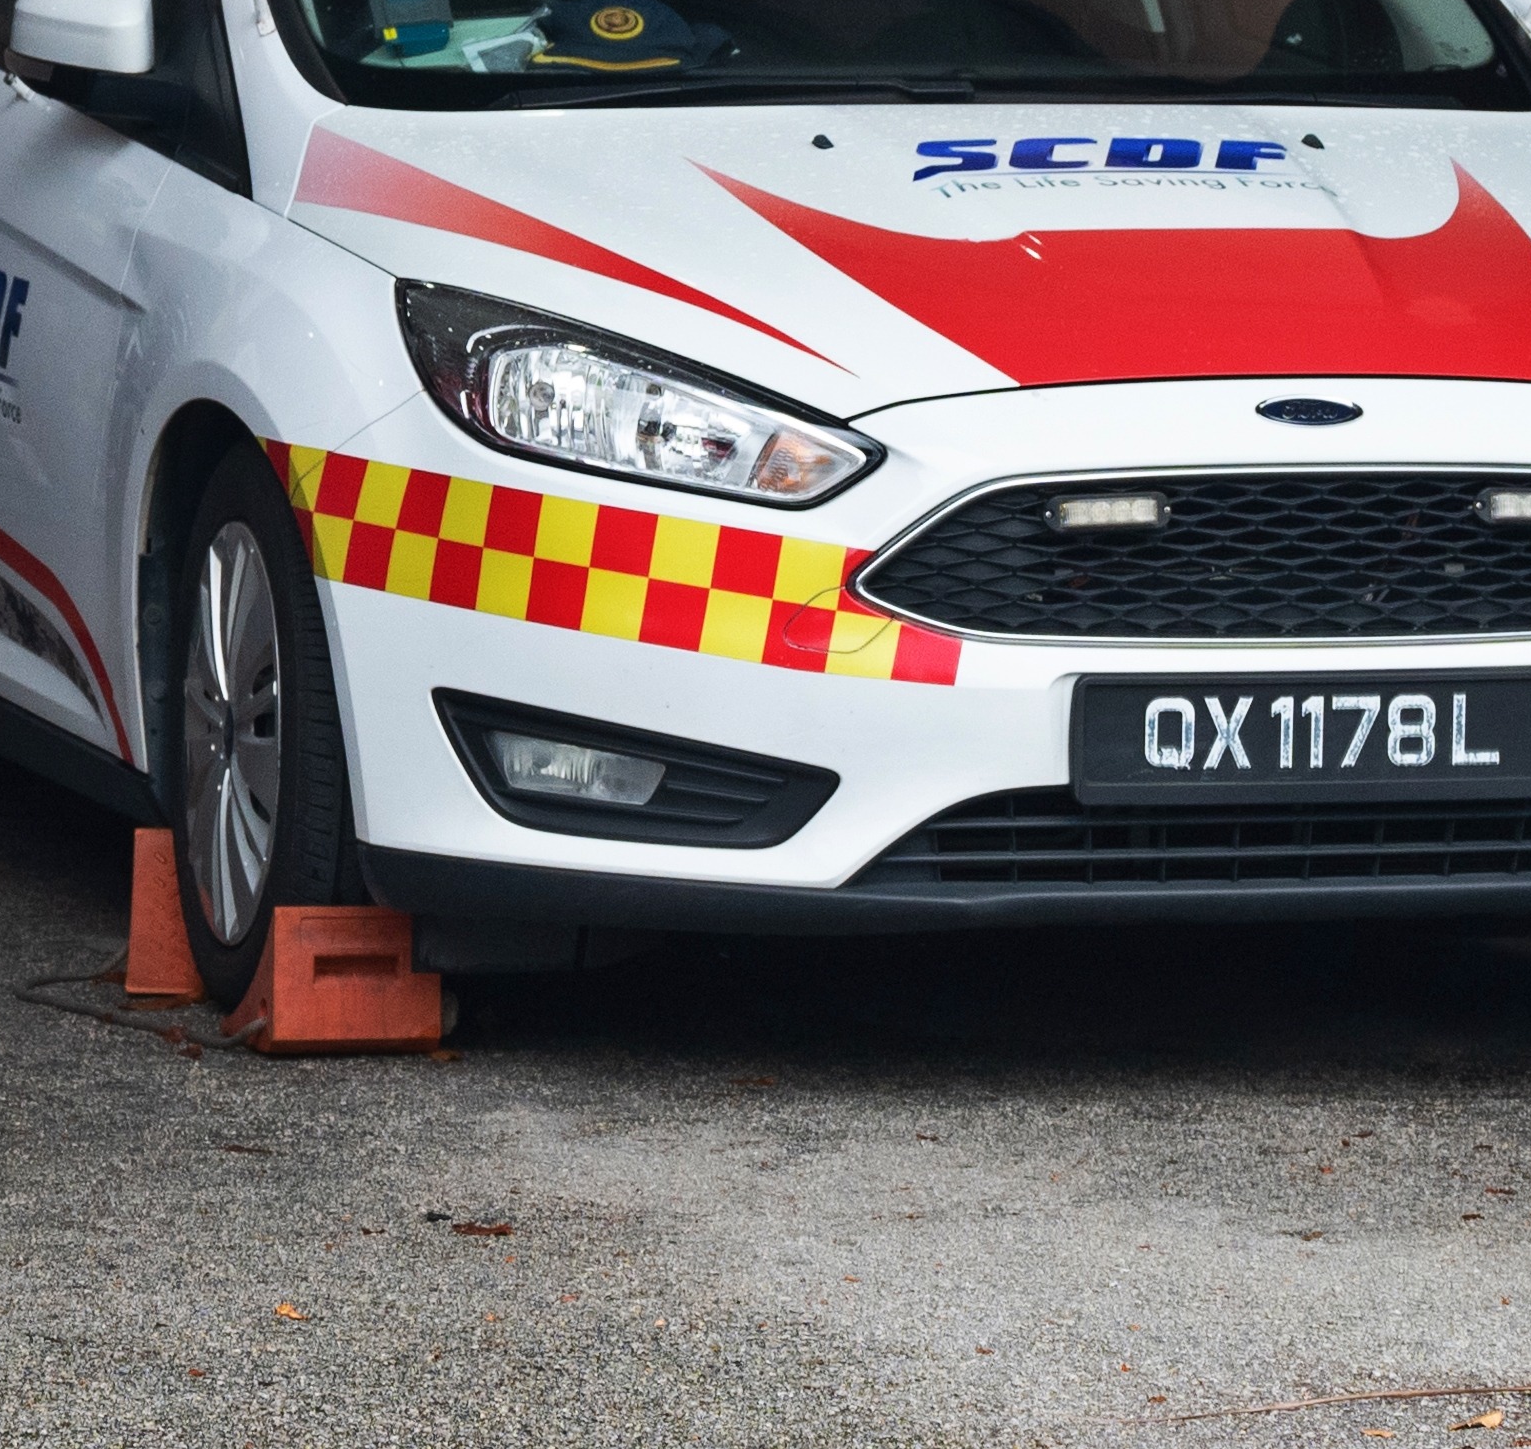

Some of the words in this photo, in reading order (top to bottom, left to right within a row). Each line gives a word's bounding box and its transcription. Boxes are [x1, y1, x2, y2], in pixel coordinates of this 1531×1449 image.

[912, 137, 1288, 181] SCDF
[930, 178, 1002, 198] The
[1014, 175, 1080, 189] Life
[1093, 174, 1227, 190] Saving
